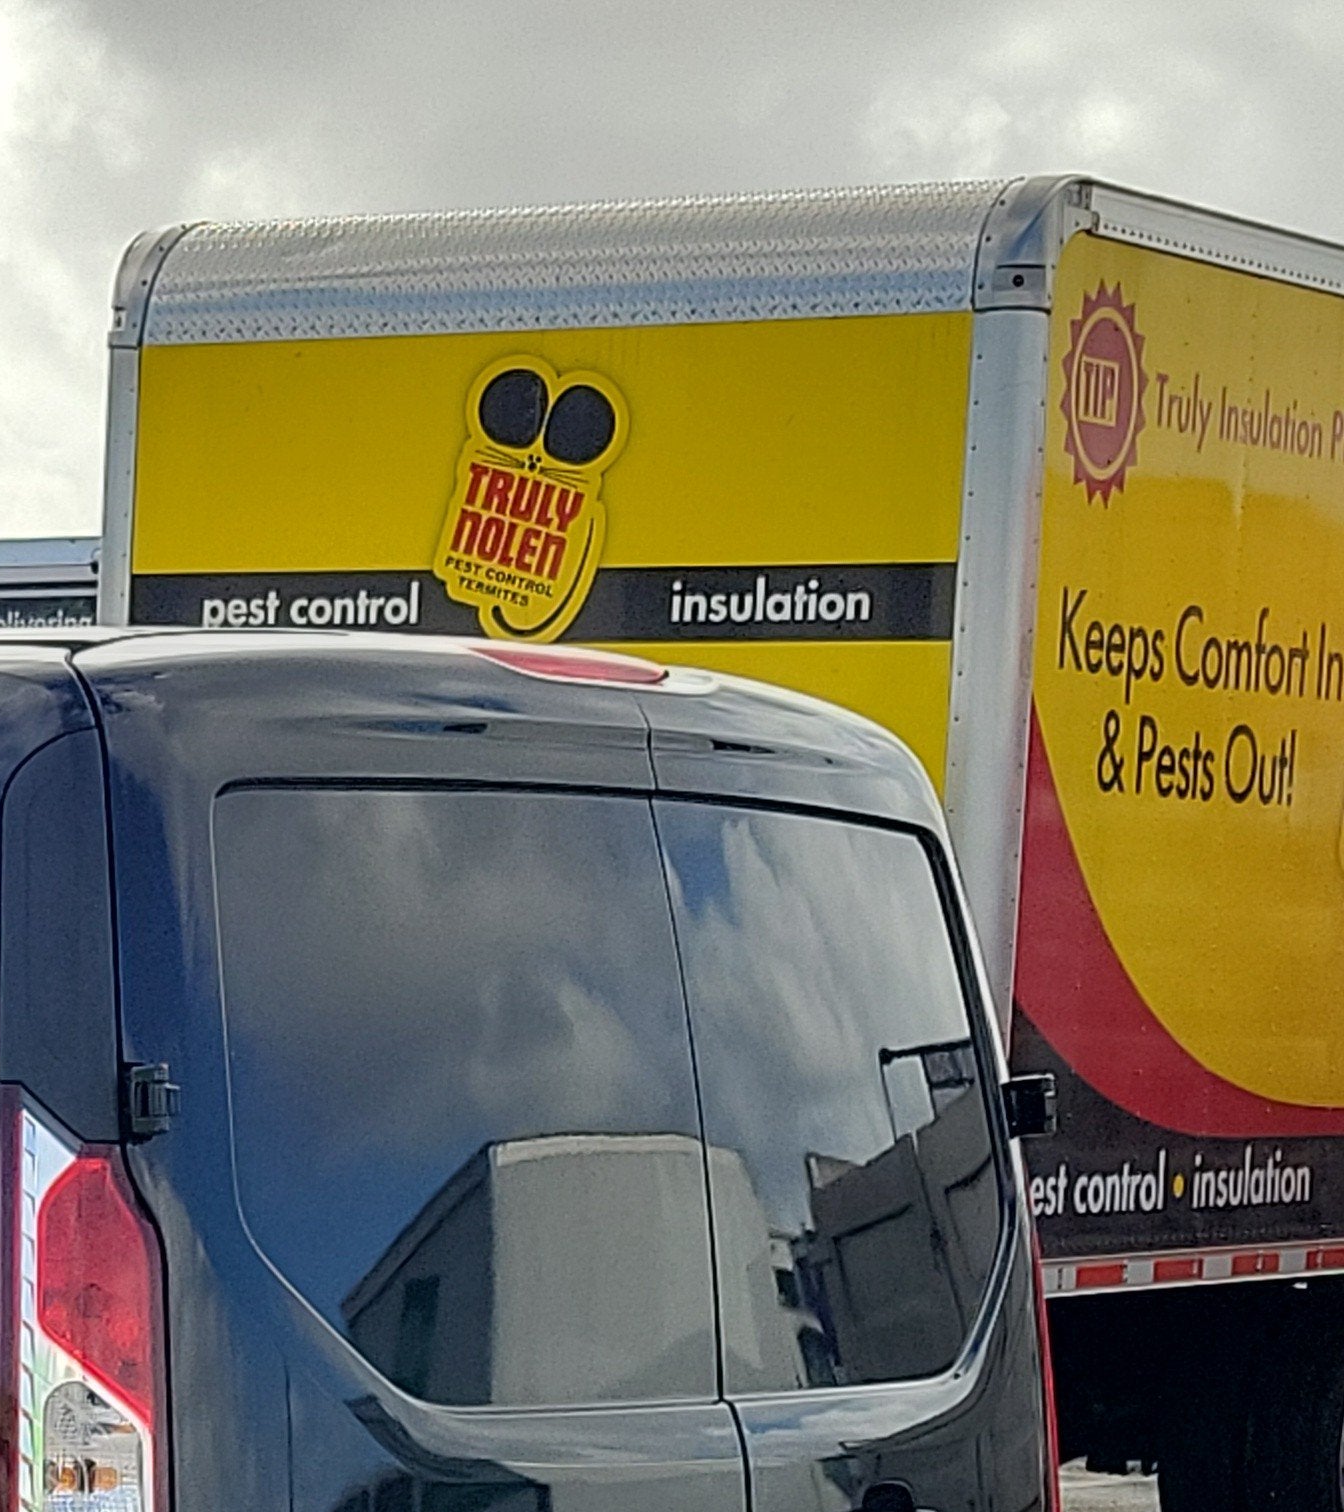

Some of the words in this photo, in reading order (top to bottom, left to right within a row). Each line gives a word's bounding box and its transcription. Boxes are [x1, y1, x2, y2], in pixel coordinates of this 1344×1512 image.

[1082, 361, 1116, 423] TIP
[1156, 373, 1212, 452] Truly
[1219, 385, 1322, 459] Insulation
[1330, 409, 1344, 460] P
[464, 462, 585, 533] TRULY
[445, 555, 482, 577] PEST
[485, 567, 554, 599] CONTROL
[450, 508, 567, 581] NOLEN
[203, 590, 280, 628] pest
[289, 580, 420, 625] control
[458, 576, 530, 608] TERMITES
[670, 574, 871, 623] insulation
[1058, 585, 1165, 706] Keeps
[1175, 604, 1310, 699] Comfort
[1316, 621, 1344, 701] In
[1097, 709, 1126, 794] &
[1135, 714, 1215, 803] Pests
[1224, 723, 1297, 807] Out!
[1030, 1163, 1068, 1217] est
[1073, 1147, 1166, 1214] control
[1191, 1141, 1311, 1209] insulation
